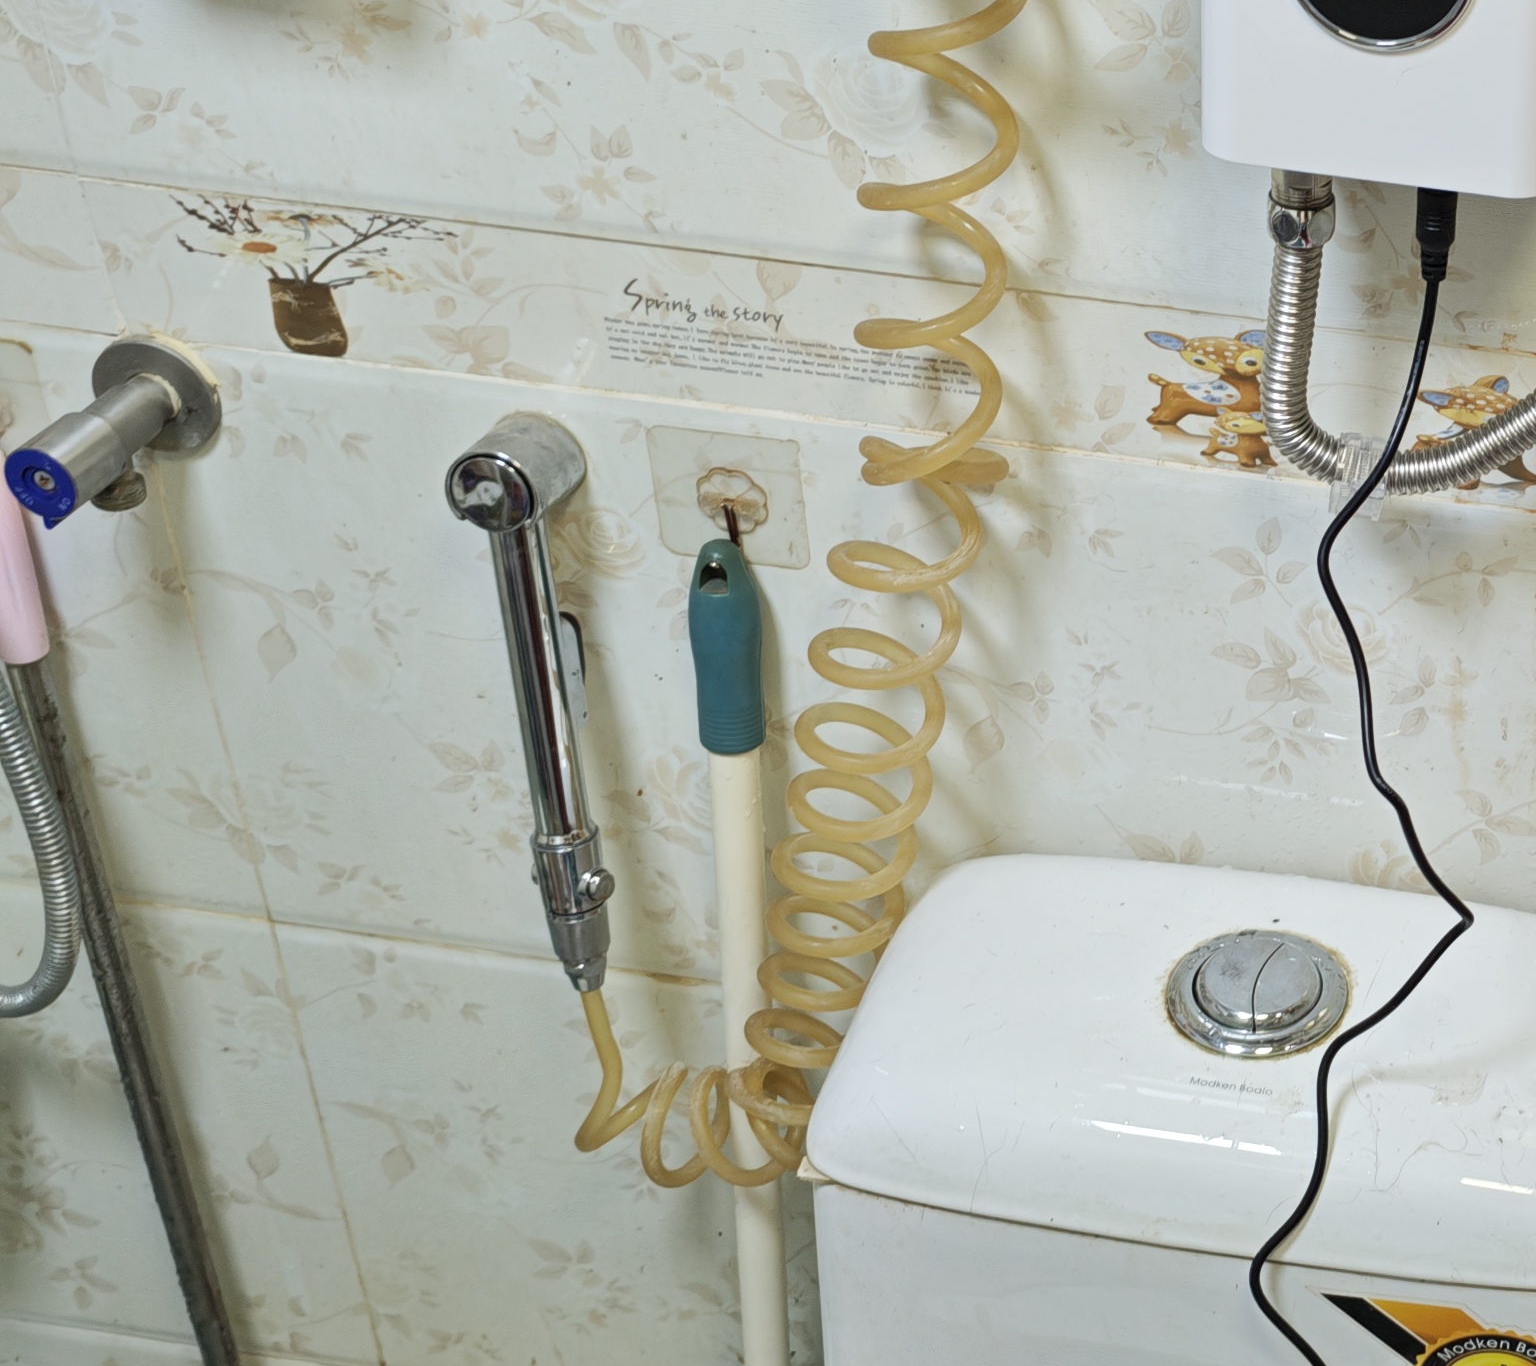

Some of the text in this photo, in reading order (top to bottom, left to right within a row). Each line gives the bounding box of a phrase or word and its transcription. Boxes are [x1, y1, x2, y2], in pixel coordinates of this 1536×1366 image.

[622, 278, 785, 333] Spring the story
[1189, 1076, 1237, 1092] Modken
[1436, 1337, 1511, 1363] Modken
